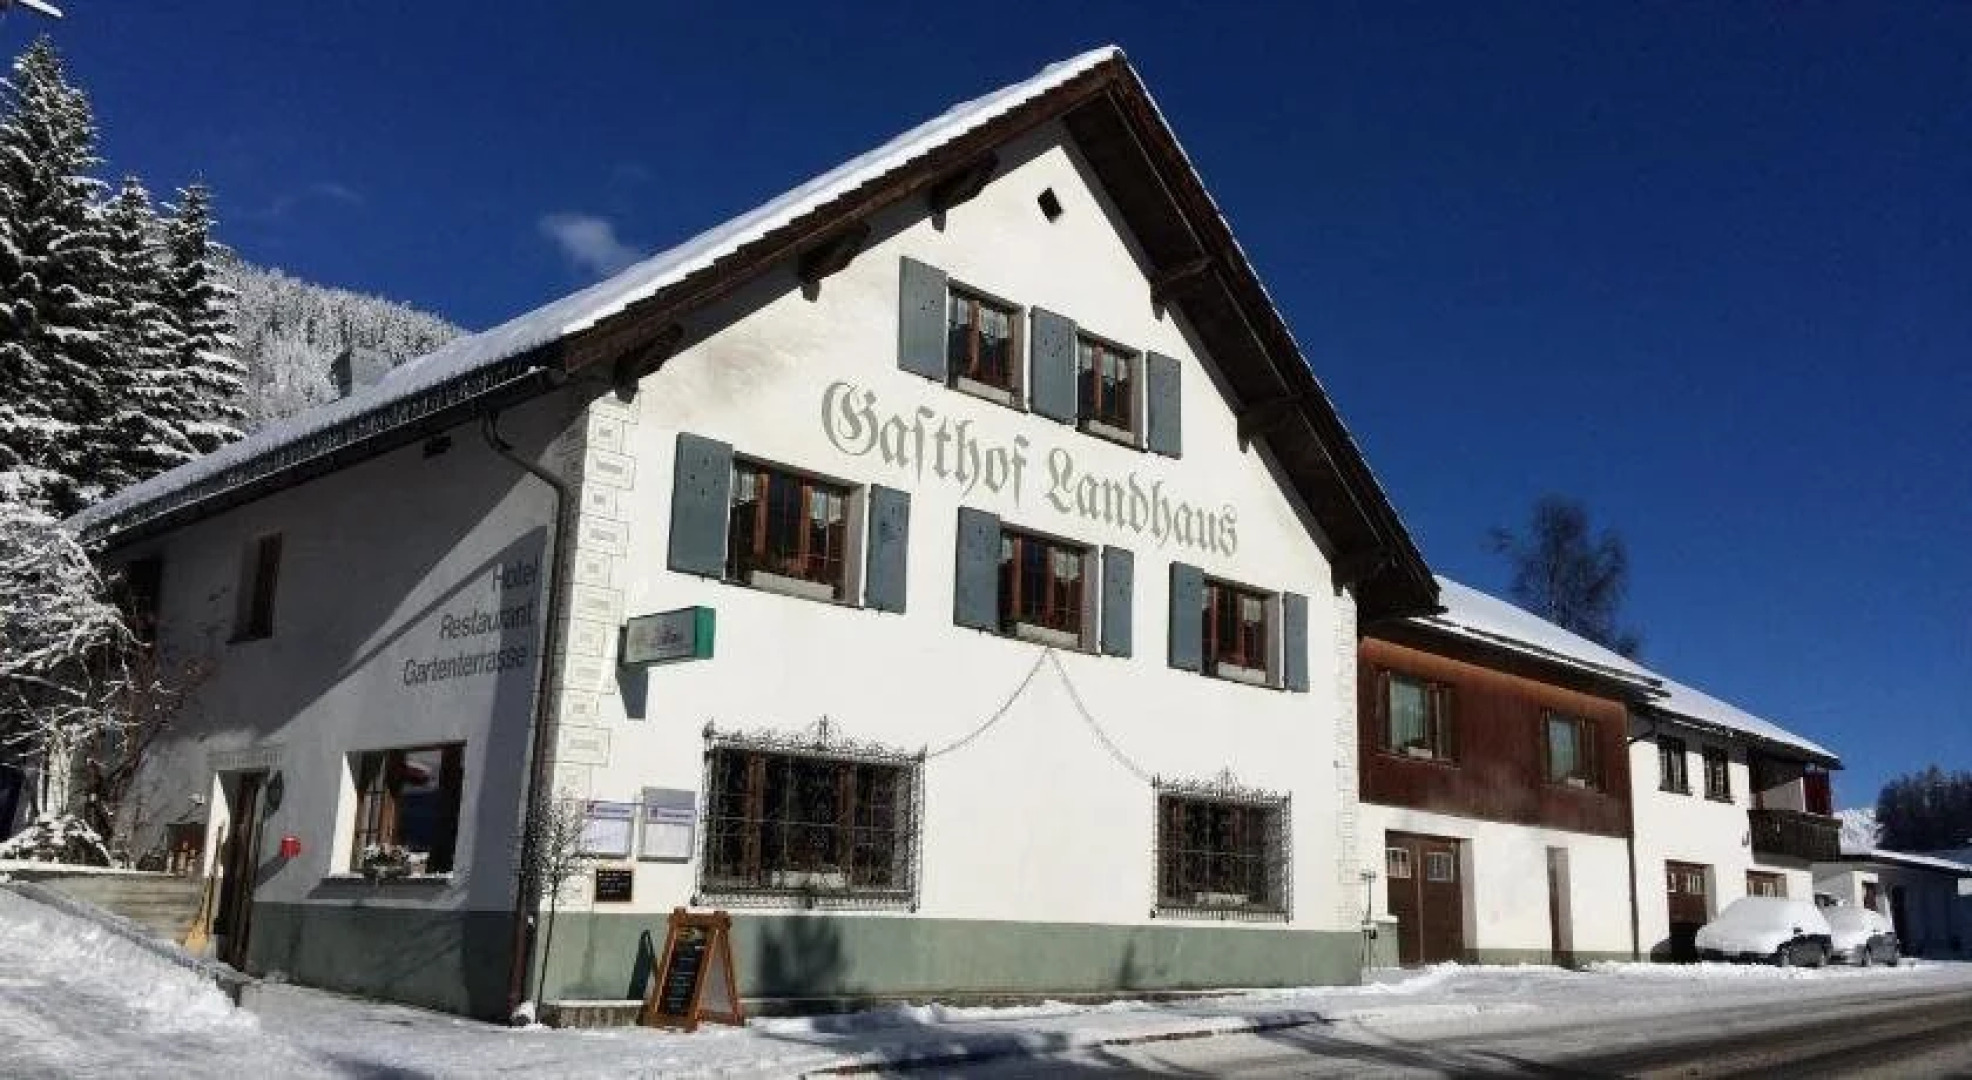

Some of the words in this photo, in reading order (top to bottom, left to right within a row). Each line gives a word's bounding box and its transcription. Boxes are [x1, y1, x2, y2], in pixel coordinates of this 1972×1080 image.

[1045, 447, 1239, 558] Landhaus
[492, 554, 538, 592] Hotel
[439, 602, 533, 639] Restaurant
[403, 648, 526, 685] Gartenterrasse
